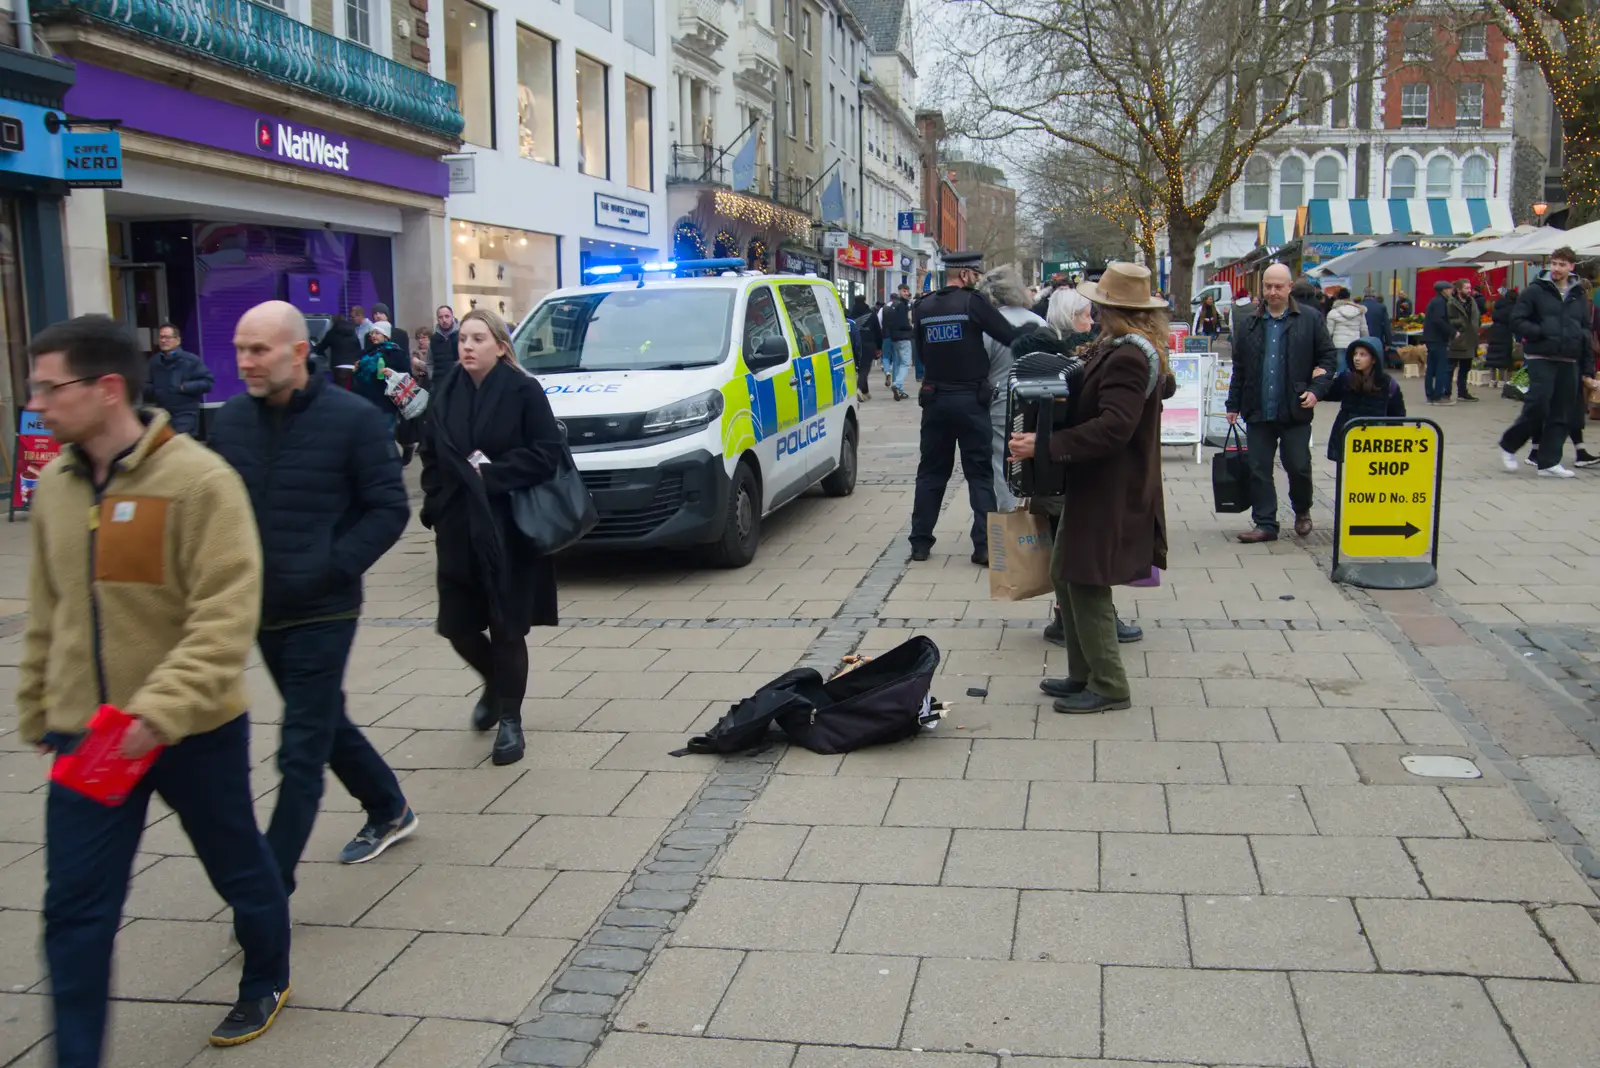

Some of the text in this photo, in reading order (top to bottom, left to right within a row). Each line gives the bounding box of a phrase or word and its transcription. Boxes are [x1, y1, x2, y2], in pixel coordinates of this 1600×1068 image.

[278, 123, 349, 171] NatWest
[66, 156, 118, 169] NERO
[927, 325, 959, 341] POLICE
[543, 384, 622, 395] OLICE
[776, 417, 827, 461] POLICE
[1352, 438, 1428, 453] BARBER'S
[1368, 461, 1410, 476] SHOP
[1348, 492, 1427, 504] ROW D No. 85
